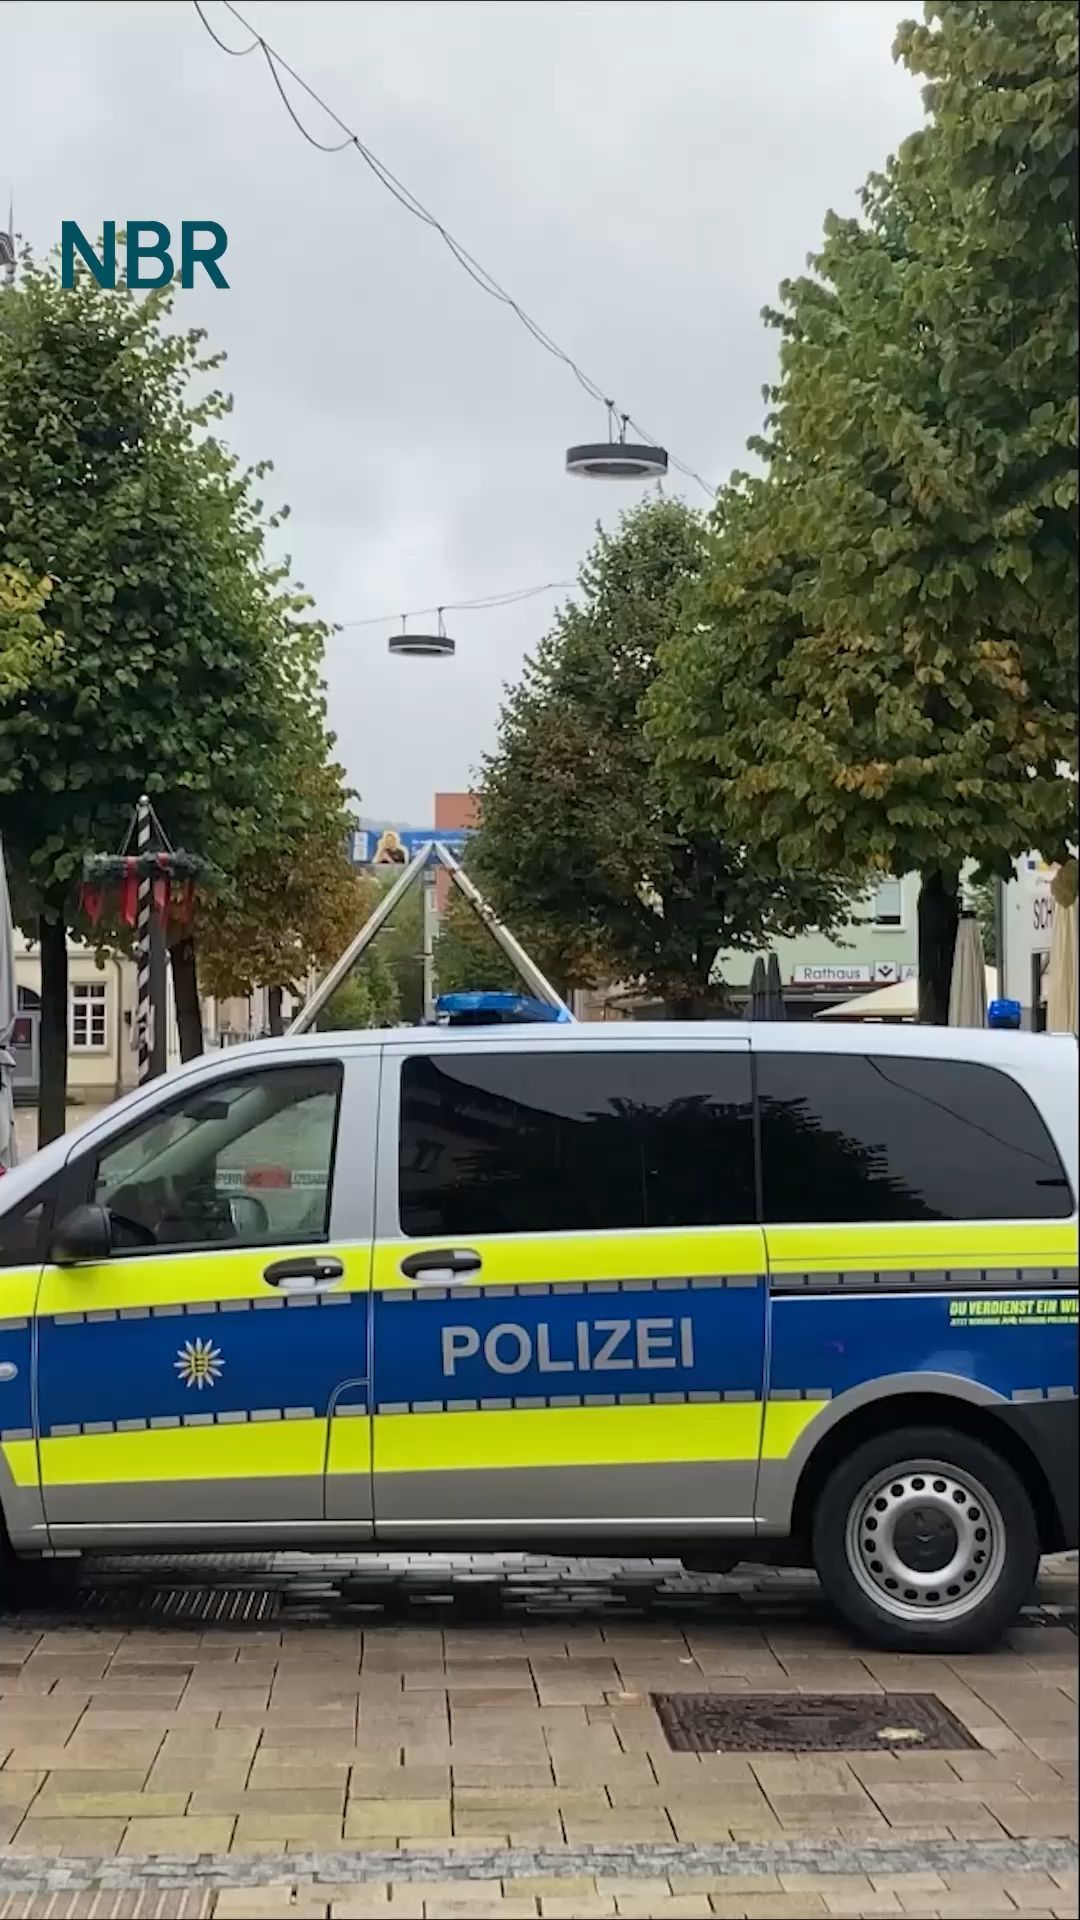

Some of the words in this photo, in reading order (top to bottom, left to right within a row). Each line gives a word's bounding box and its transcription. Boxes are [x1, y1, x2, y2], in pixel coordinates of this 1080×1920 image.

[804, 967, 861, 980] Rathaus
[949, 1301, 967, 1316] DU
[968, 1300, 1035, 1315] VERDIENST
[1036, 1299, 1058, 1314] EIN
[441, 1316, 694, 1377] POLIZEI
